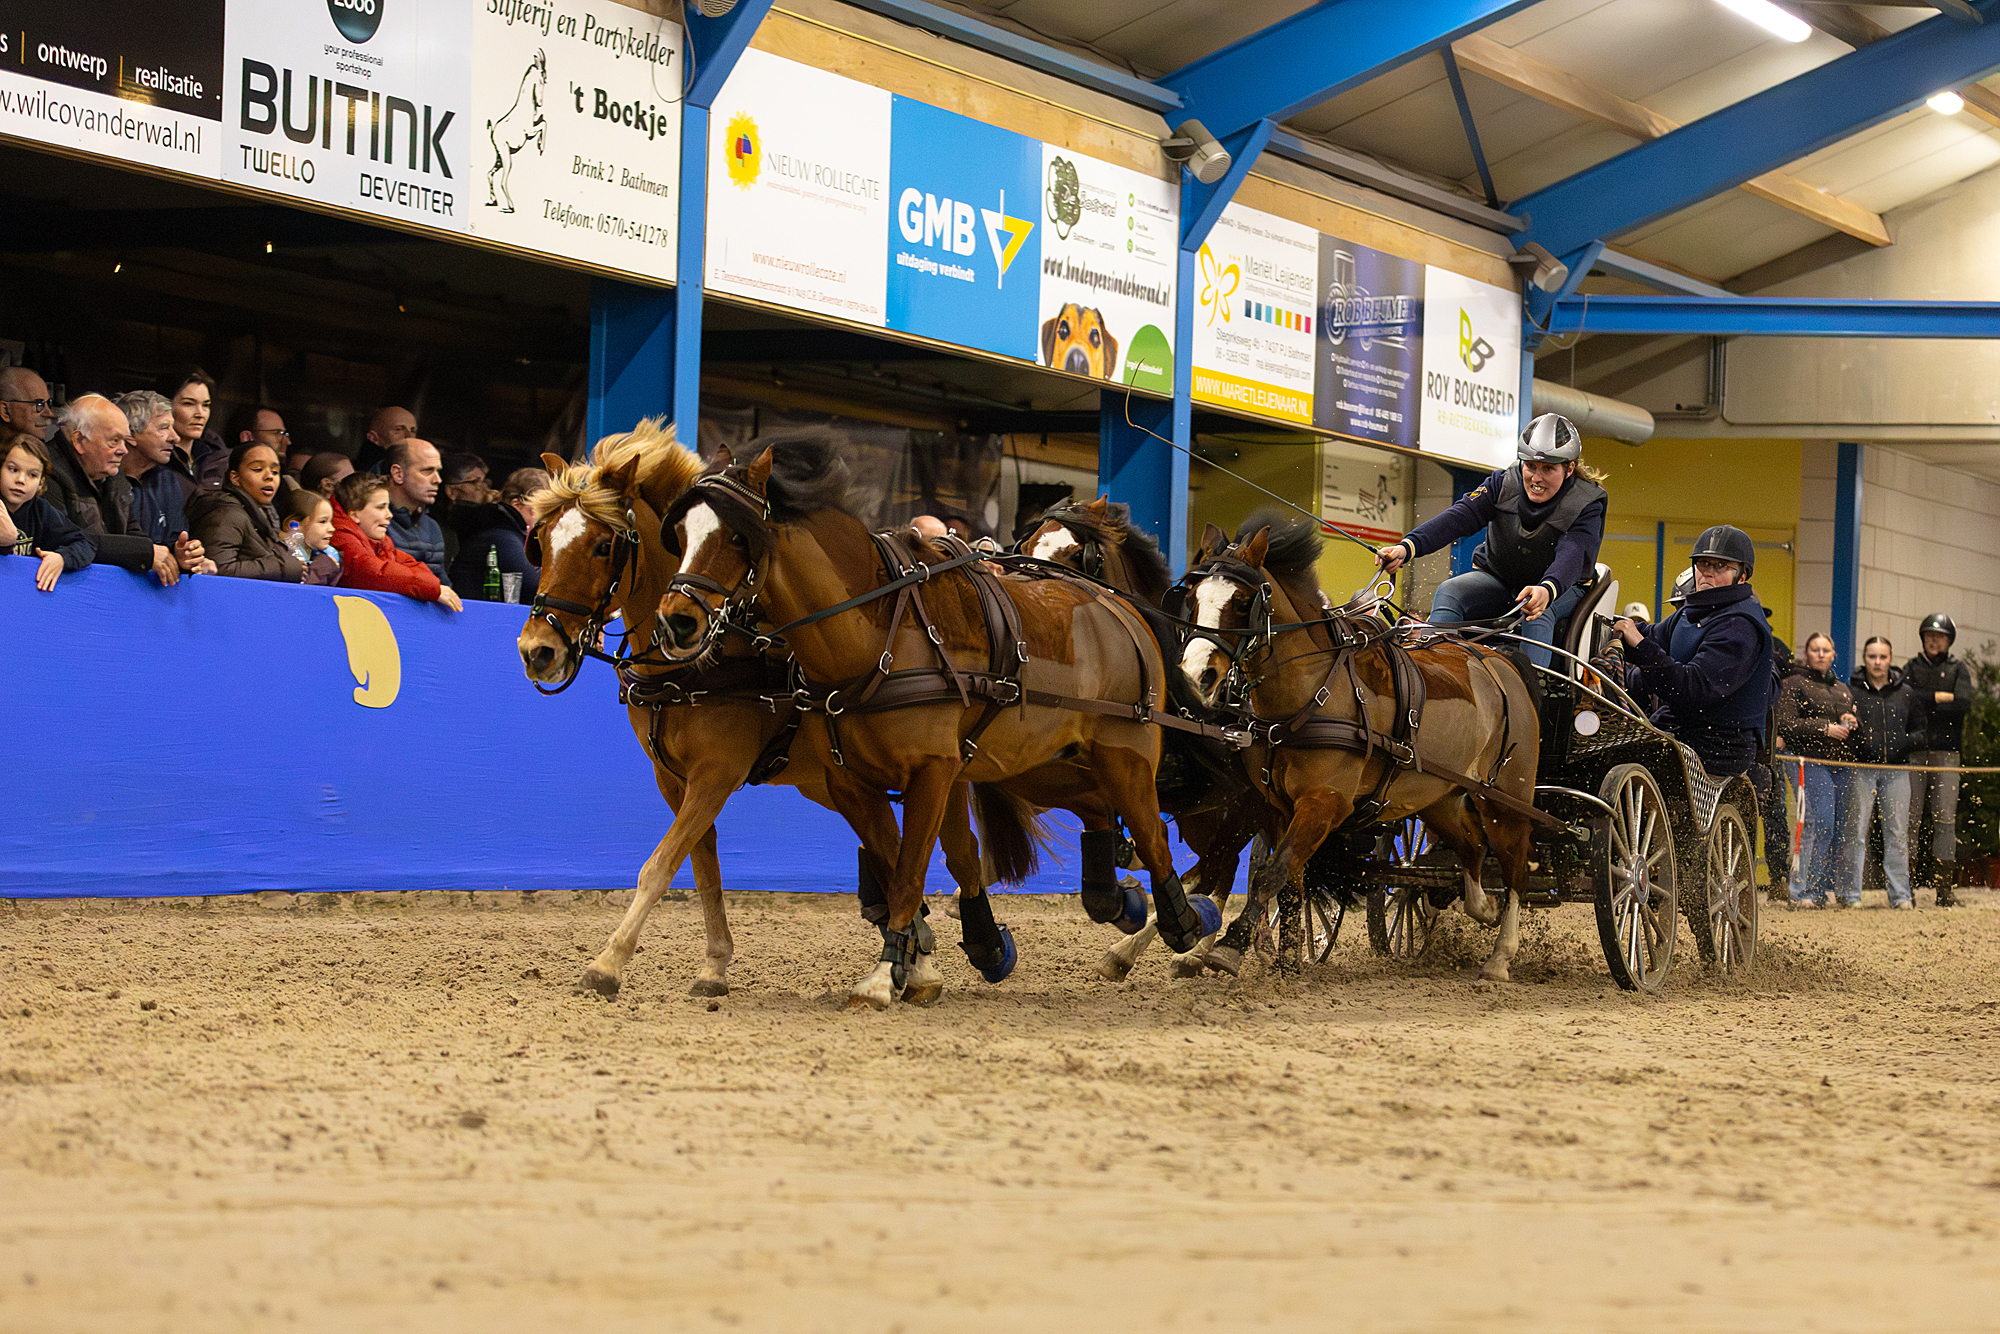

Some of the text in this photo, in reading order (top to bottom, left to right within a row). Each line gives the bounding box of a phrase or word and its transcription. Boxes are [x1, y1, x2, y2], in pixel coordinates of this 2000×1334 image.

[324, 44, 383, 66] your professional
[557, 14, 576, 37] en
[581, 13, 675, 67] Partykelder
[38, 42, 108, 81] ontwerp
[135, 66, 204, 99] realisatie
[336, 61, 372, 80] sportshop
[240, 57, 456, 179] BUITINK
[569, 80, 668, 141] 't Bockje
[240, 144, 315, 184] TWELLO
[572, 155, 669, 198] Brink 2 Bathmen
[767, 152, 812, 182] NIEUW
[814, 164, 880, 201] ROLLECATE
[360, 172, 454, 217] DEVENTER
[543, 198, 669, 248] Telefoon: 0570-541278
[898, 187, 976, 257] GMB
[896, 251, 975, 283] uitdaging verbindt
[1427, 371, 1450, 402] ROY
[1454, 378, 1514, 416] BOKSEBELD
